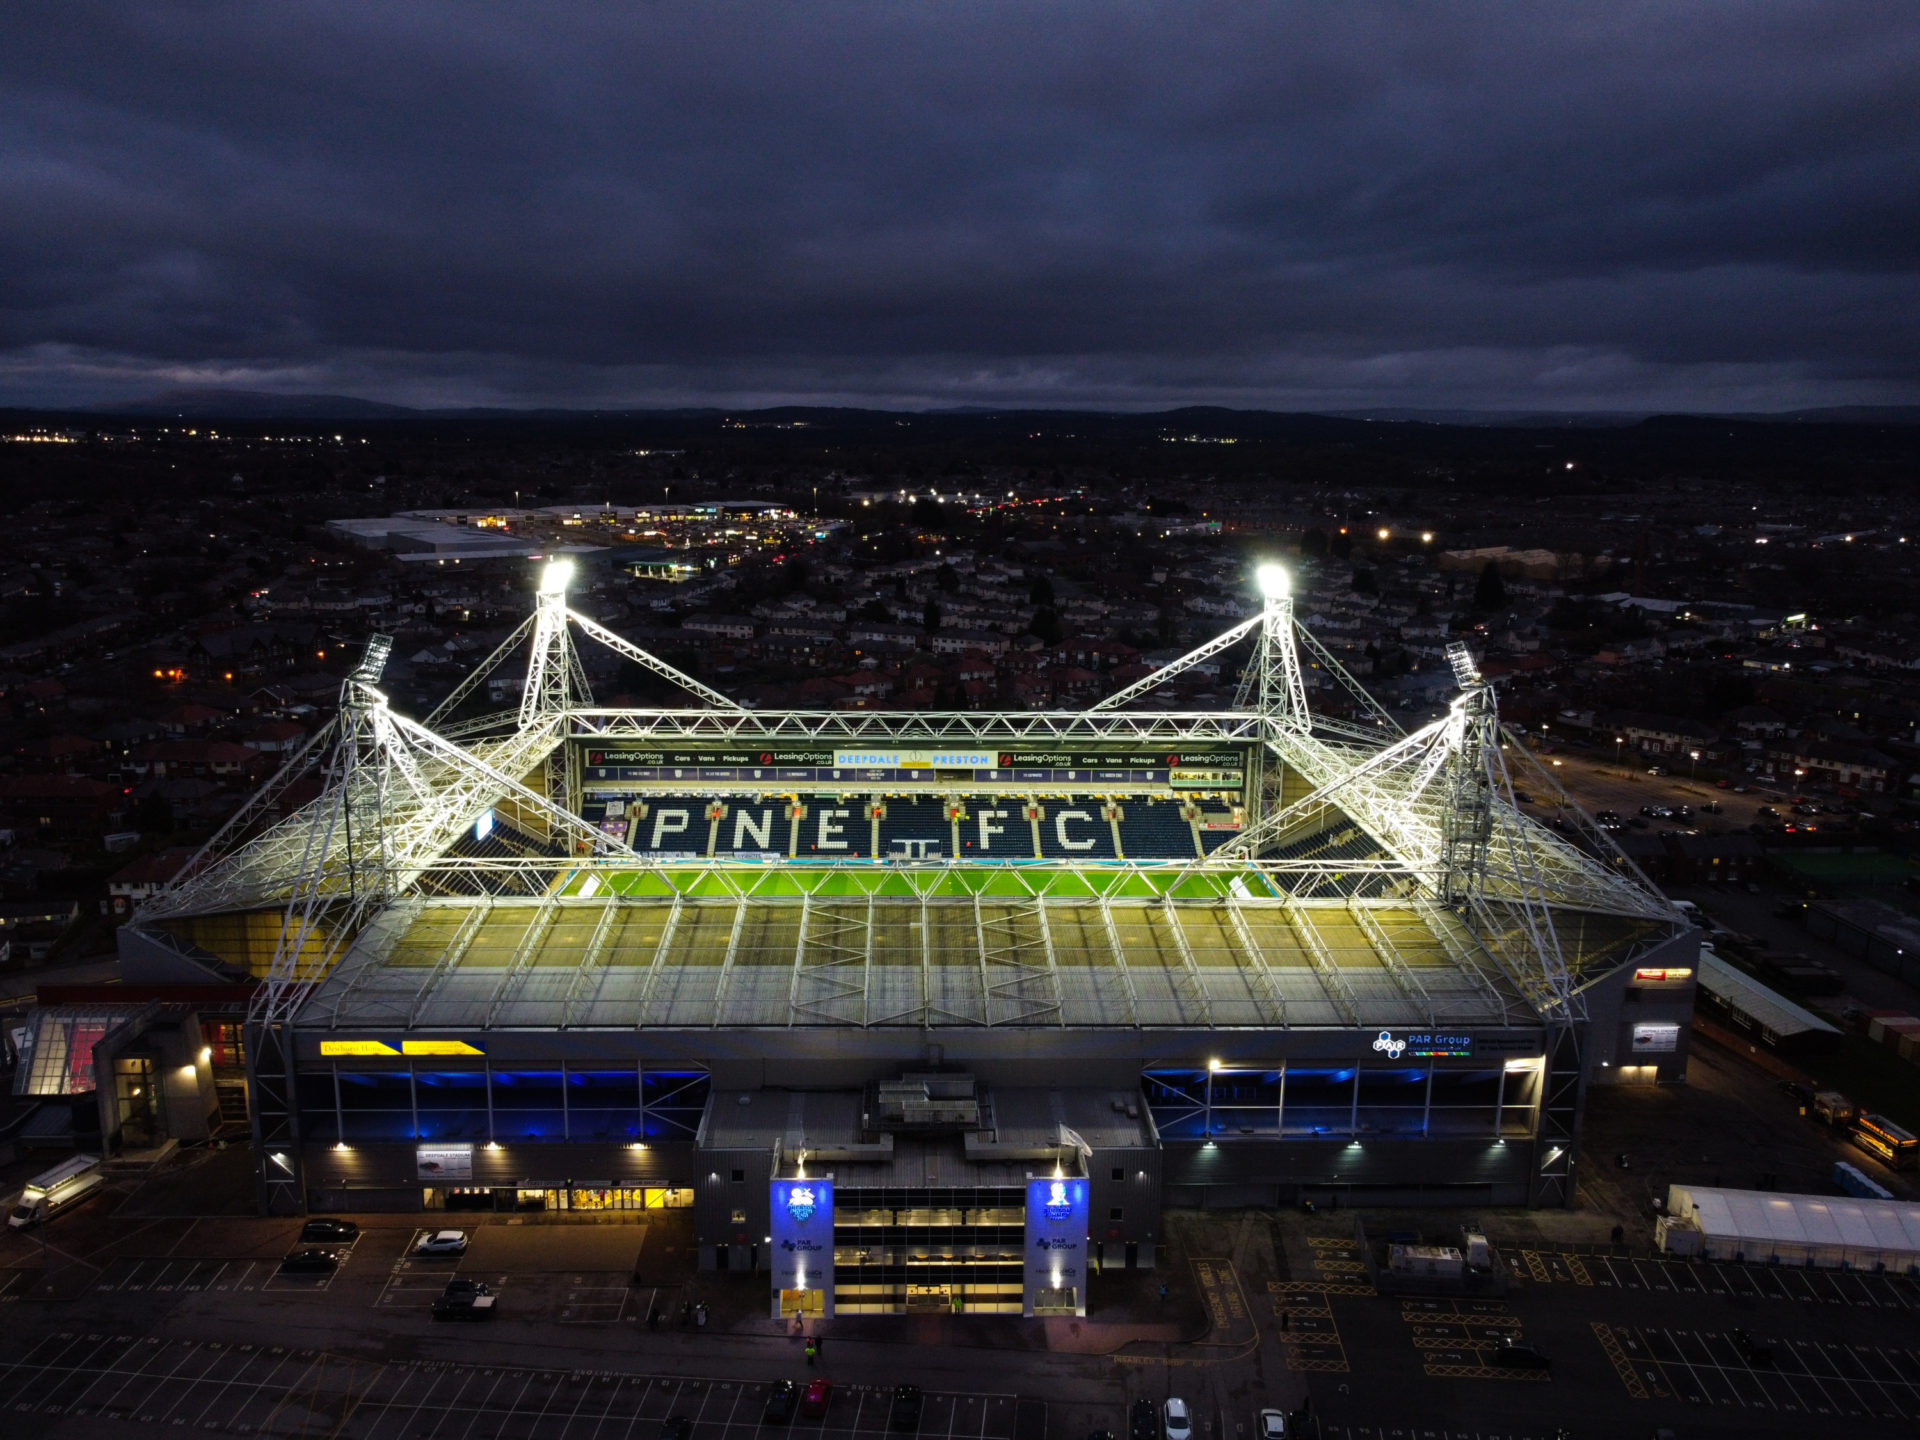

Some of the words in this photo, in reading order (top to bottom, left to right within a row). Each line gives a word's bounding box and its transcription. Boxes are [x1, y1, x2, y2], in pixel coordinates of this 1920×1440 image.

[605, 752, 664, 762] LeasingOptions
[722, 755, 748, 763] Pickups
[774, 752, 832, 762] LeasingOptions
[838, 755, 899, 764] DEEPDALE
[933, 756, 988, 764] PRESTON
[1014, 754, 1072, 763] LeasingOptions
[1130, 757, 1156, 765] Pickups
[1180, 754, 1238, 764] LeasingOptions
[1408, 1034, 1431, 1043] PAR
[1435, 1034, 1470, 1047] Group
